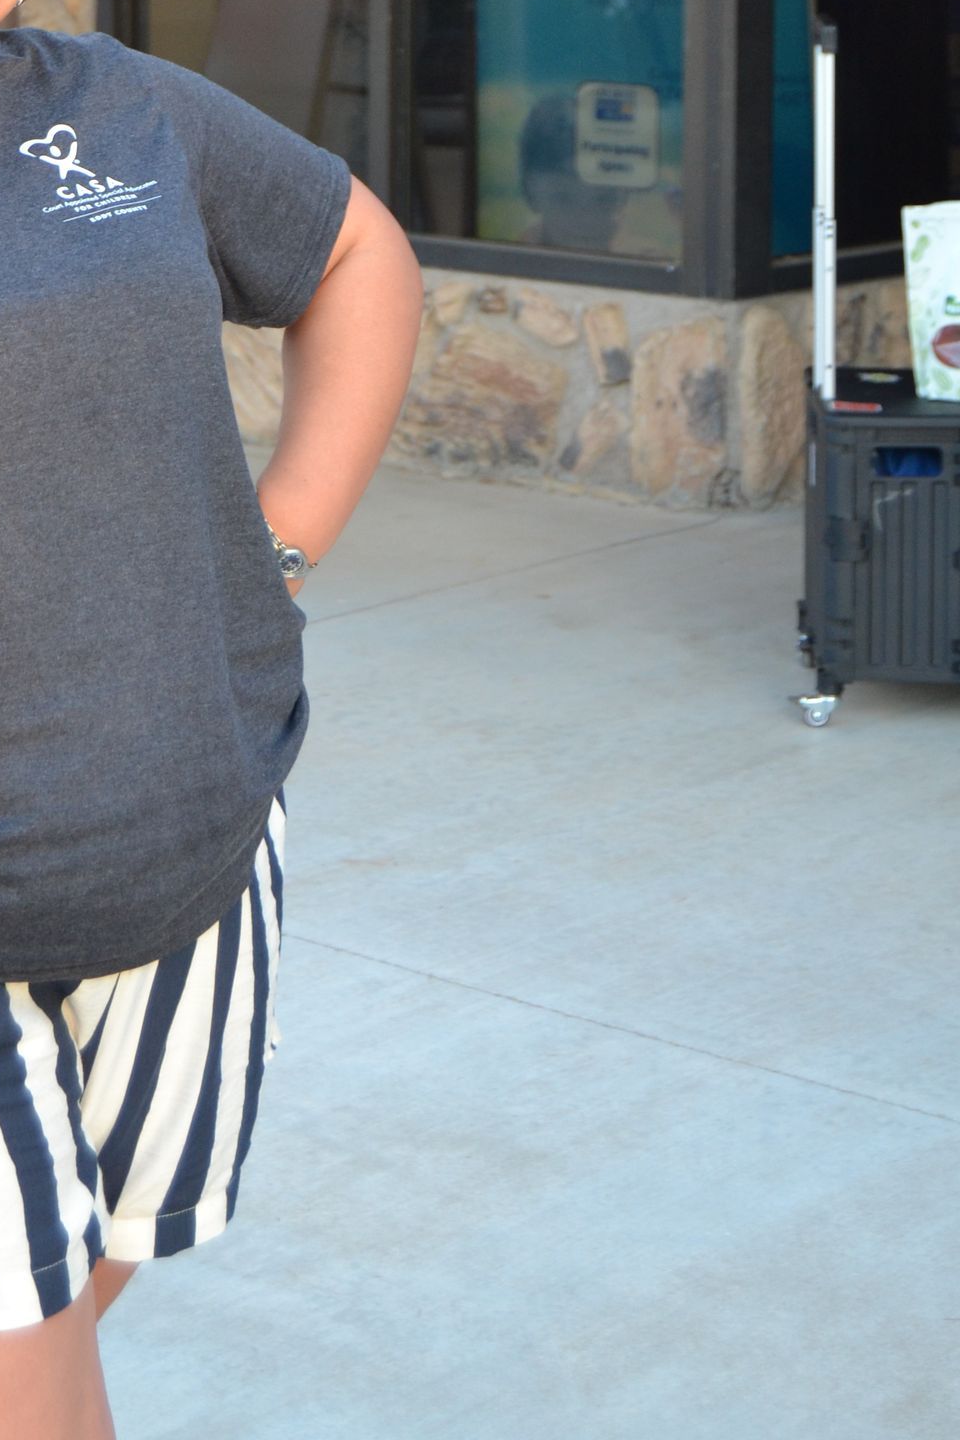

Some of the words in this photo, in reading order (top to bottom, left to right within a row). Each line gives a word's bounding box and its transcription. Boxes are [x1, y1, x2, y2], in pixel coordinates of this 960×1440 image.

[56, 176, 125, 199] CASA
[42, 203, 63, 213] Court
[64, 195, 99, 208] Appointed
[99, 187, 124, 199] Special
[74, 204, 93, 213] FOR
[94, 194, 138, 208] CHILDREN
[89, 212, 113, 223] EDDY
[114, 204, 148, 216] COUNTY
